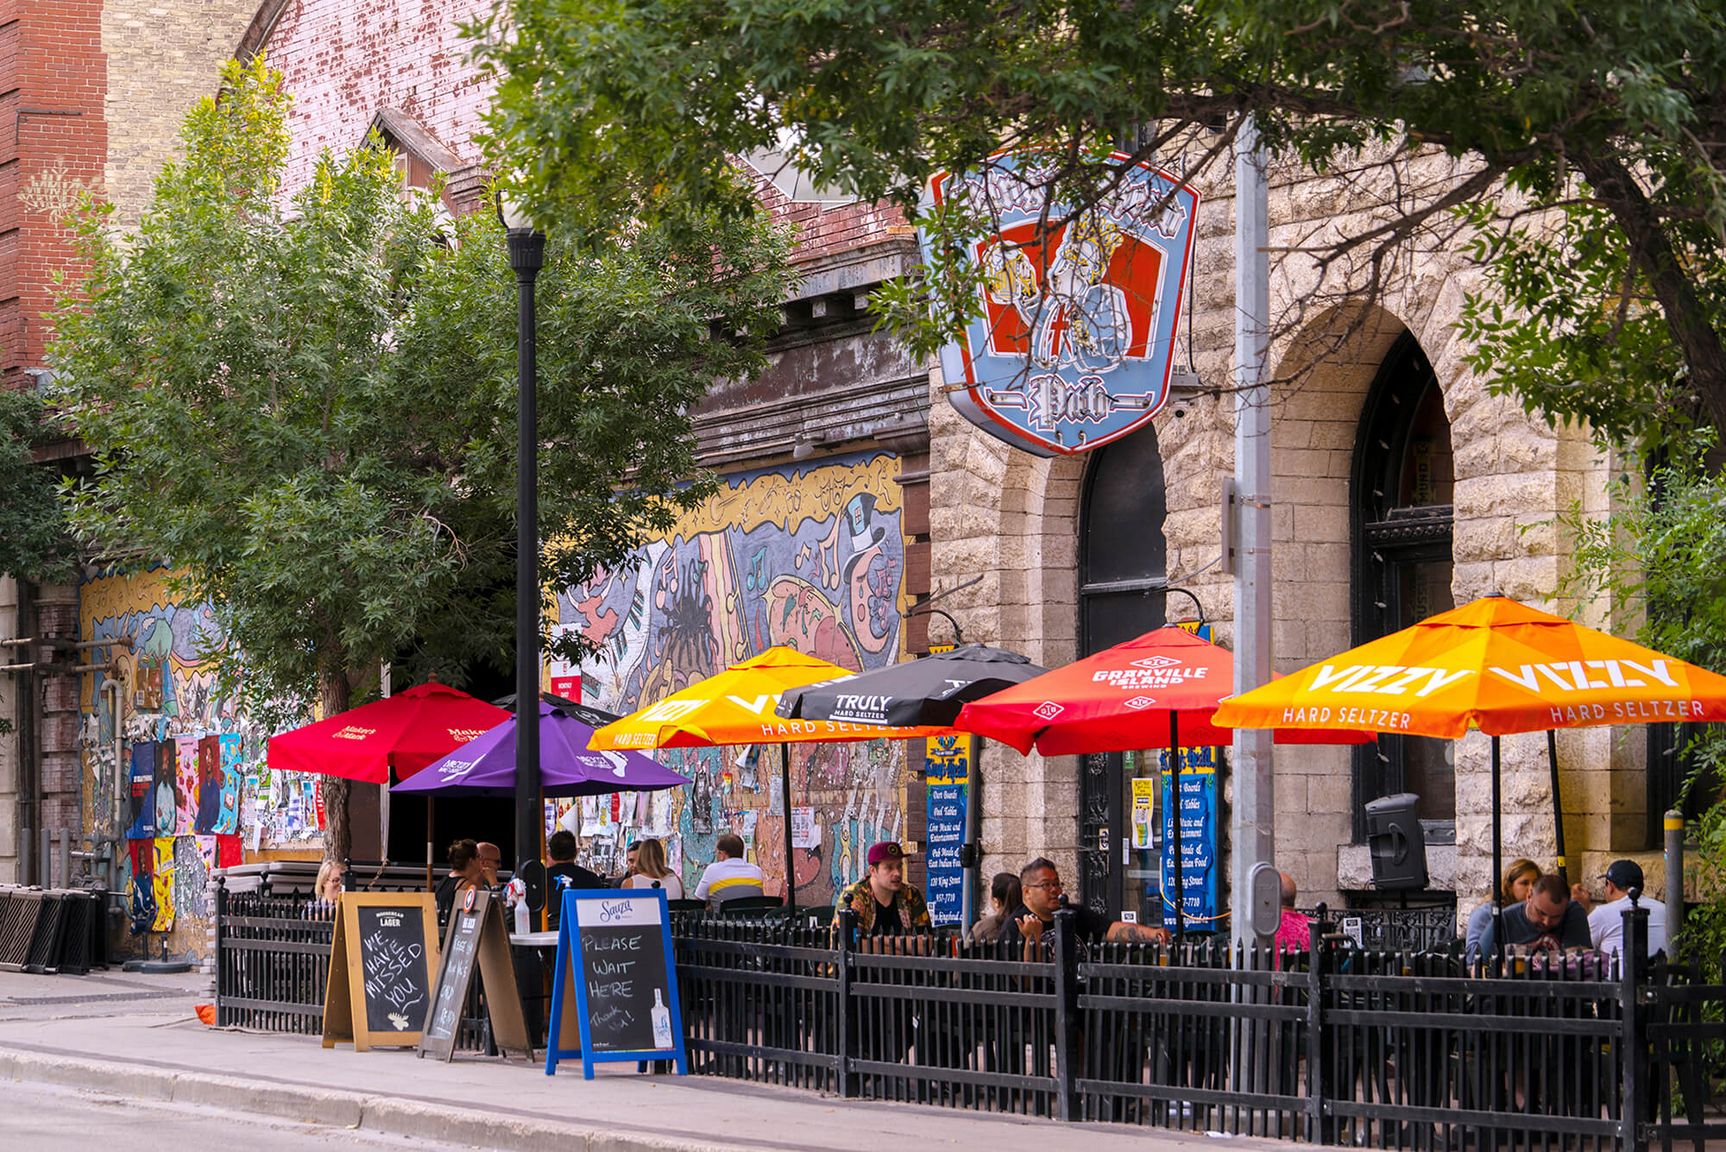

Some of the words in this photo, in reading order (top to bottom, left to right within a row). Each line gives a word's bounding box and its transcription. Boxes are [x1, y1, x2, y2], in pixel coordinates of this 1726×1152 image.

[1092, 667, 1208, 682] GRANVILLE
[1109, 676, 1184, 687] ISLAND
[1308, 665, 1477, 697] VIZZY
[1488, 660, 1679, 693] VIZZY
[834, 709, 854, 717] HARD
[855, 711, 885, 719] SELTZER
[1282, 706, 1331, 723] HARD
[1338, 707, 1411, 729] SELTZER
[1551, 703, 1605, 723] HARD
[1614, 701, 1704, 719] SELTZER
[762, 721, 817, 736] HARD
[613, 733, 632, 746] HARD
[632, 732, 657, 746] SELTZER
[952, 820, 962, 831] and
[1194, 816, 1205, 828] and
[1195, 844, 1203, 855] &
[600, 899, 633, 923] Sauza
[380, 918, 401, 927] LAGER
[581, 934, 641, 952] PLEASE
[366, 939, 404, 974] HAVE
[366, 943, 421, 999] MISSED
[593, 959, 636, 975] WAIT
[385, 978, 418, 1008] YOU
[589, 980, 633, 998] HERE
[590, 1005, 622, 1027] Thank
